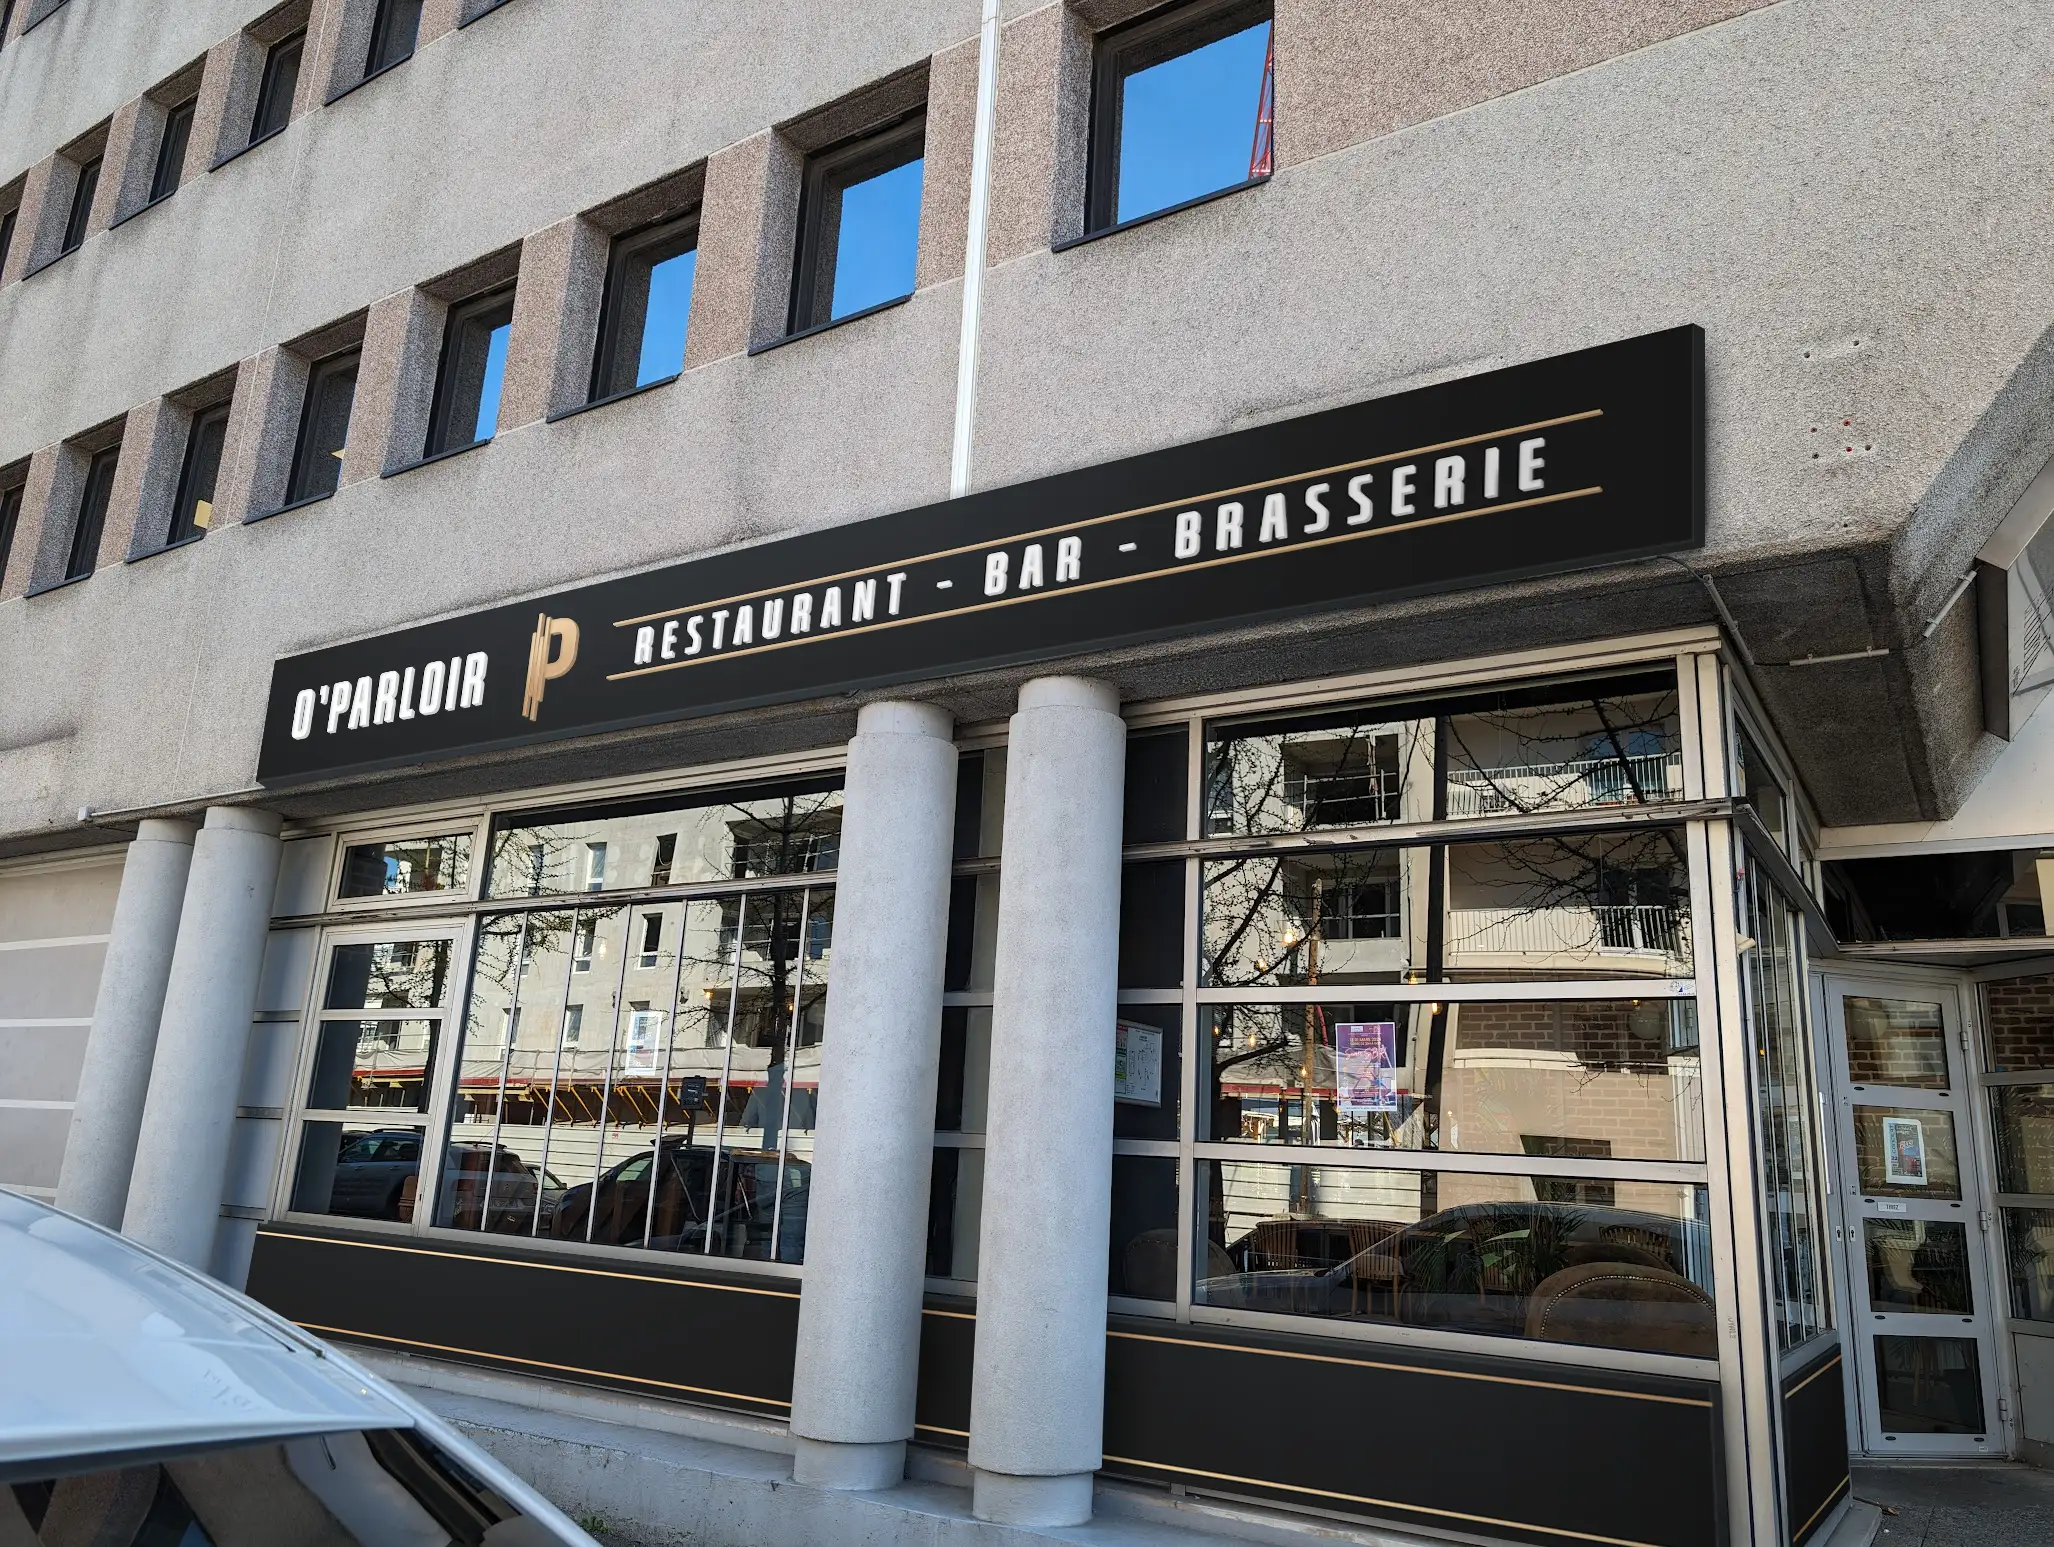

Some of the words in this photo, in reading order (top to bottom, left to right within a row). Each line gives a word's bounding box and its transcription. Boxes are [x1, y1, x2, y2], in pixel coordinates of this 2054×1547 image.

[633, 571, 908, 667] RESTAURANT
[934, 578, 954, 590] -
[983, 535, 1083, 598] BAR
[1117, 541, 1138, 553] -
[1173, 436, 1546, 561] BRASSERIE
[290, 650, 490, 742] O'PARLOIR
